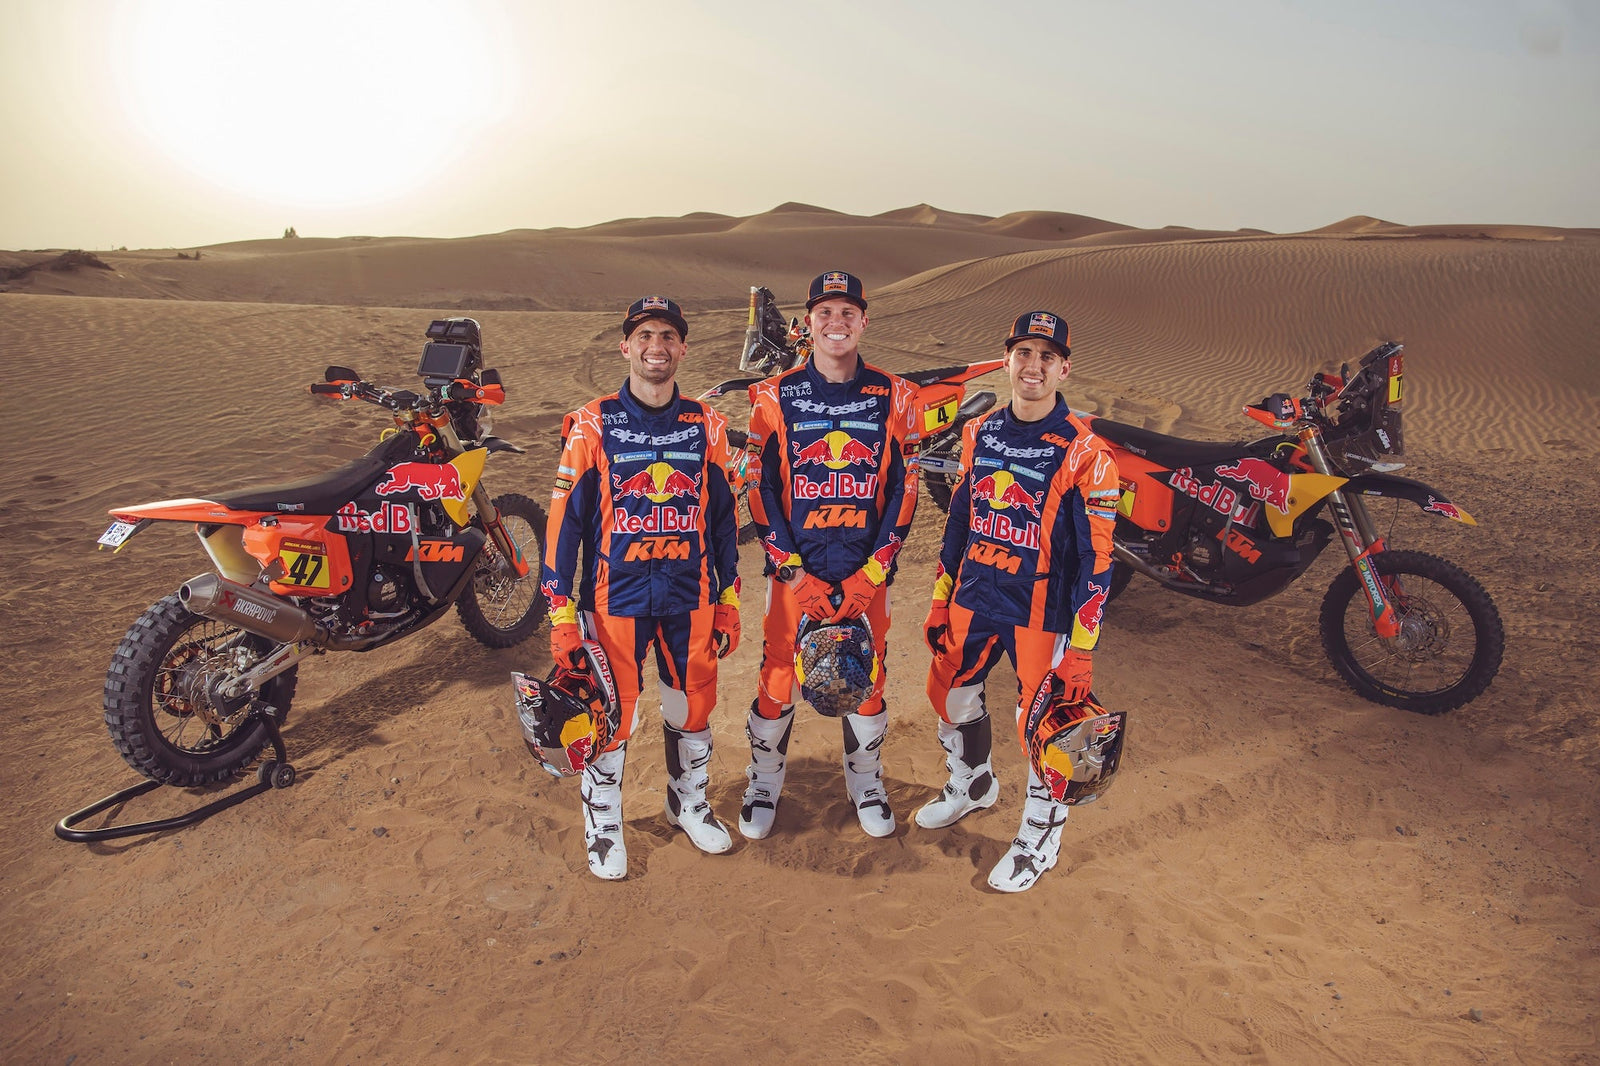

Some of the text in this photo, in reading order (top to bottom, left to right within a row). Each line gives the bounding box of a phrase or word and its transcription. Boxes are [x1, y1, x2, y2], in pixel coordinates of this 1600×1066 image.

[781, 388, 812, 398] AIR BAG
[860, 385, 889, 396] KTM
[678, 412, 704, 423] KTM
[791, 397, 878, 416] alpinestars
[937, 405, 950, 424] 4
[614, 417, 629, 425] BAG
[609, 425, 699, 446] alpinestars
[982, 434, 1055, 459] alpinestars
[1040, 432, 1070, 449] KTM
[794, 472, 878, 499] Red Bull
[1168, 467, 1222, 507] Red
[337, 501, 390, 534] Red
[612, 506, 700, 534] Red Bull
[803, 504, 868, 529] KTM
[994, 515, 1041, 550] Bull
[404, 540, 465, 562] KTM
[624, 536, 691, 562] KTM
[967, 540, 1023, 576] KTM
[1215, 527, 1262, 565] KTM
[288, 553, 323, 586] 47
[1362, 571, 1384, 608] MOTOREX
